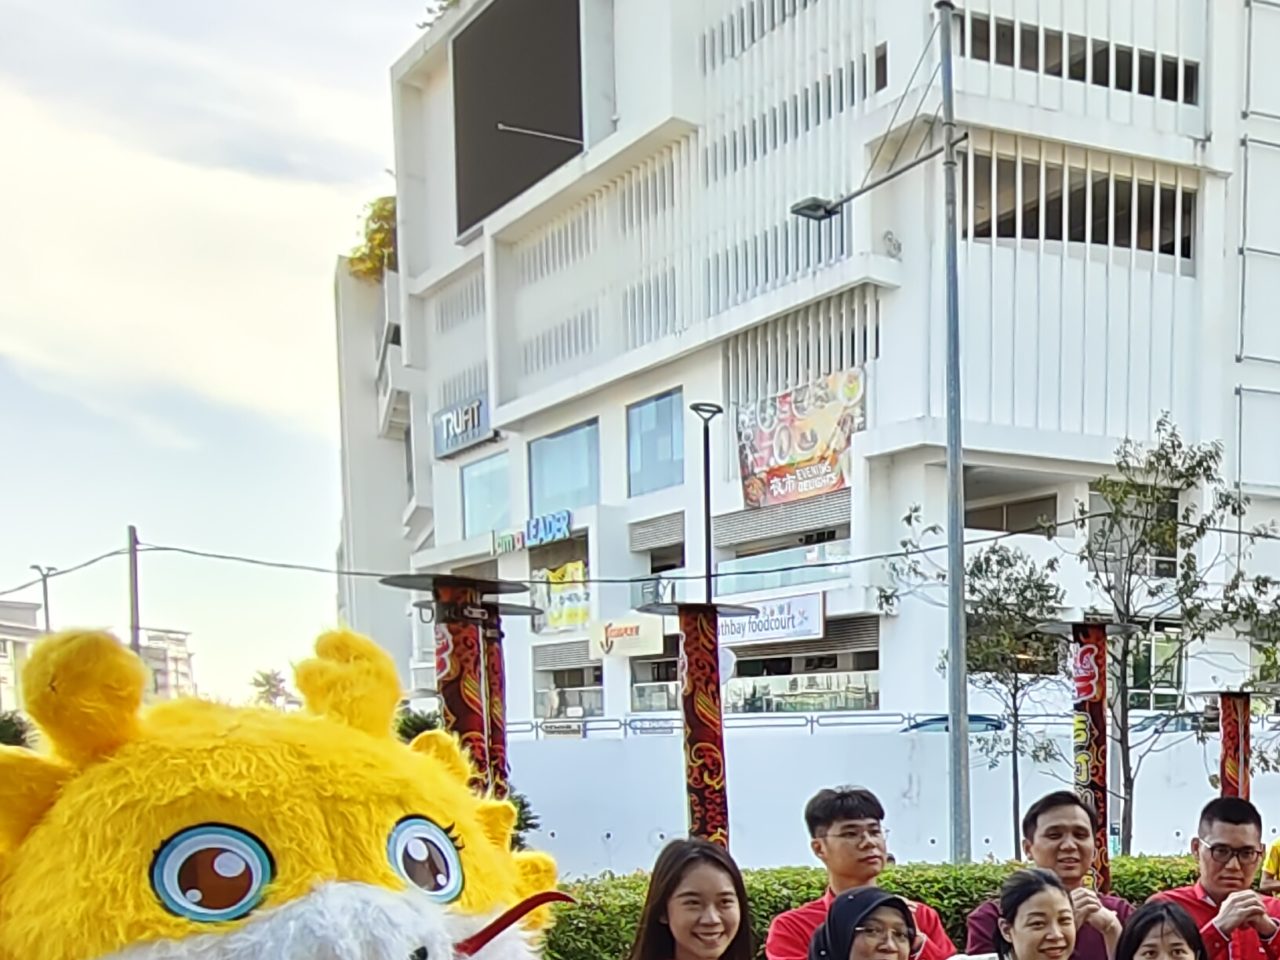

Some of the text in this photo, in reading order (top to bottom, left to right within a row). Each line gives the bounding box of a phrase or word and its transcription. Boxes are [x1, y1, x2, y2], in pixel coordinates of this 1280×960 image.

[796, 461, 832, 481] EVENING
[797, 473, 838, 493] DELIGHTS
[526, 509, 572, 549] LEADER
[748, 613, 797, 633] foodcourt
